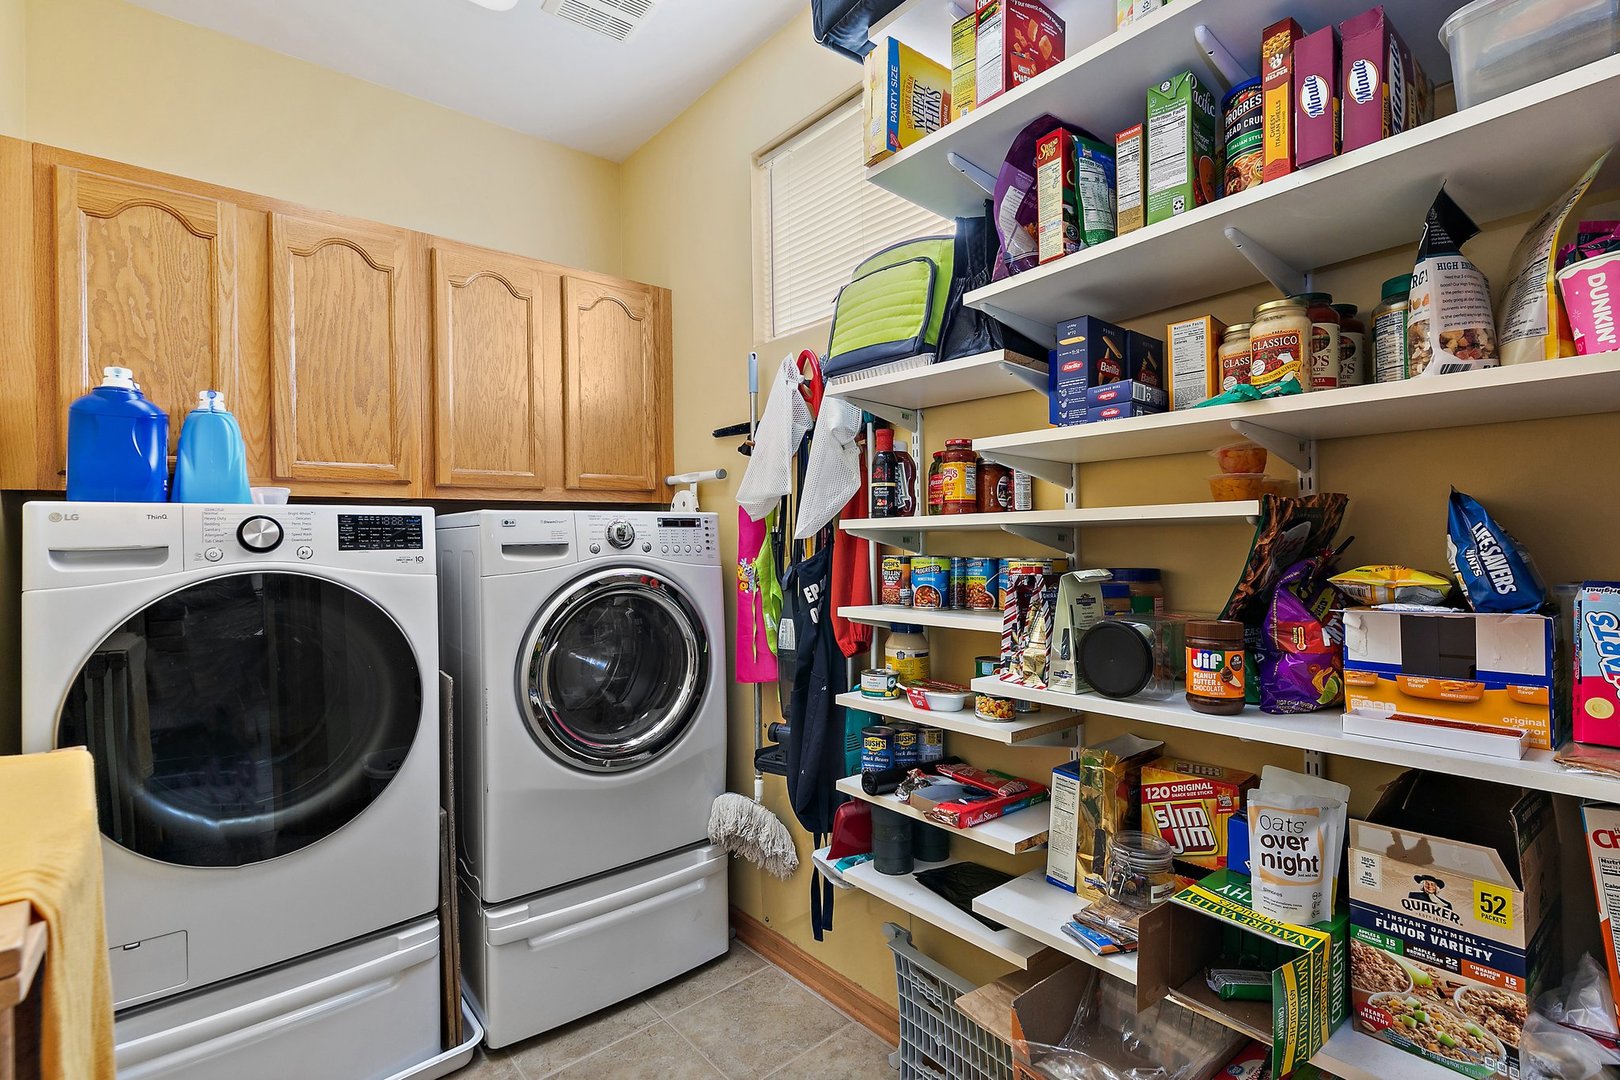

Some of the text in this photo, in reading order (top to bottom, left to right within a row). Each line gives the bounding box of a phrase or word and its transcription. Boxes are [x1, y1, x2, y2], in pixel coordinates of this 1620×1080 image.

[1265, 67, 1288, 82] HELPER
[1352, 60, 1372, 102] Minute
[890, 65, 898, 123] PARTY SIZE
[1186, 72, 1216, 117] Pacific
[1305, 76, 1322, 116] Minute
[912, 80, 926, 130] WHEAT
[925, 86, 942, 134] THINS
[1224, 94, 1262, 127] PROGRES
[1150, 106, 1186, 124] Nutrition Facts
[1244, 114, 1262, 128] CRU
[1038, 136, 1058, 159] Stove
[1046, 146, 1056, 160] Top
[1436, 262, 1458, 271] HIGH
[1411, 269, 1428, 289] RG!
[1587, 272, 1617, 344] DUNKIN'
[1252, 335, 1298, 351] CLASSICO
[1063, 362, 1082, 371] Barilla
[1100, 362, 1120, 376] Barilla
[1224, 356, 1250, 369] CLASS
[915, 566, 940, 574] PROGRESSO
[1465, 549, 1482, 577] MINTS
[1193, 653, 1222, 669] Jif
[1502, 716, 1546, 728] original
[864, 740, 886, 749] BUSH'S
[1145, 782, 1213, 800] 120 ORIGINAL
[966, 816, 984, 828] Russell
[1154, 803, 1208, 828] slim
[1168, 827, 1216, 855] jim
[1260, 834, 1309, 852] over
[1261, 851, 1319, 876] night
[1361, 856, 1375, 864] 100%
[1402, 899, 1460, 925] QUAKER
[1480, 892, 1506, 918] 52
[1481, 913, 1507, 925] PACKETS
[1359, 929, 1376, 938] APPLES
[1387, 913, 1477, 945] INSTANT OATMEAL
[1357, 932, 1382, 943] CINNAMON
[1376, 918, 1493, 962] FLAVOR VARIETY
[1386, 938, 1396, 947] 15
[1406, 948, 1444, 964] BROWN SUGAR
[1413, 947, 1431, 955] MAPLE
[1445, 957, 1458, 966] 22
[1470, 964, 1500, 978] CINNAMON
[1480, 972, 1496, 980] SPICE
[1331, 940, 1343, 1024] CRUNCHY
[1505, 976, 1517, 986] 15
[1289, 989, 1295, 999] 49
[1296, 958, 1308, 1062] NATURE VALLEY
[1364, 1007, 1385, 1019] HEART
[1360, 1011, 1389, 1026] HEALTHY
